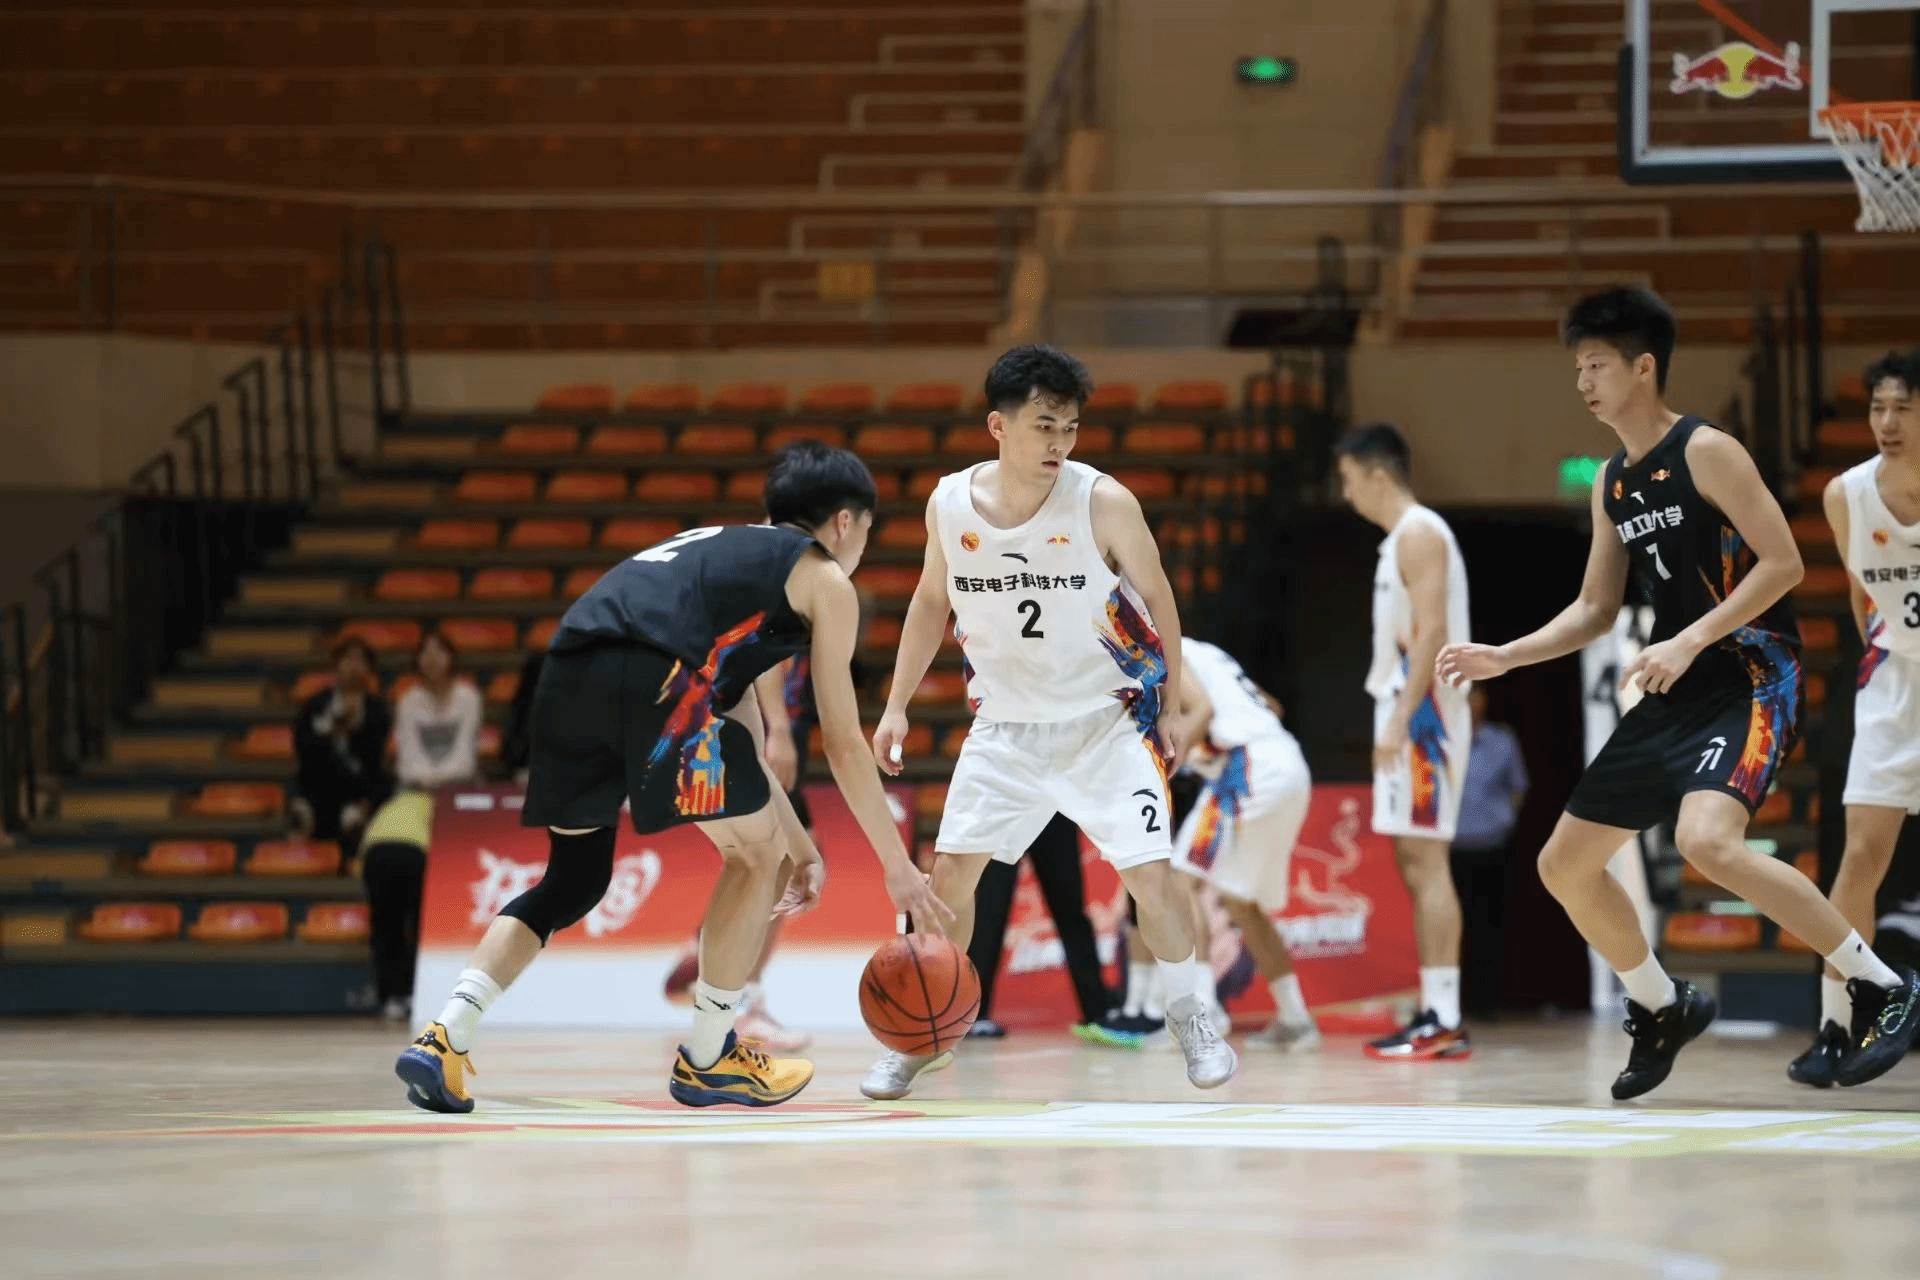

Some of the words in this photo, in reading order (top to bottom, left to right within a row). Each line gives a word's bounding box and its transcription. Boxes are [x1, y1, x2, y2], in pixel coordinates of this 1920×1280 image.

[953, 572, 1087, 593] 西安电子科技大学
[1017, 599, 1044, 639] 2
[1141, 804, 1161, 833] 2
